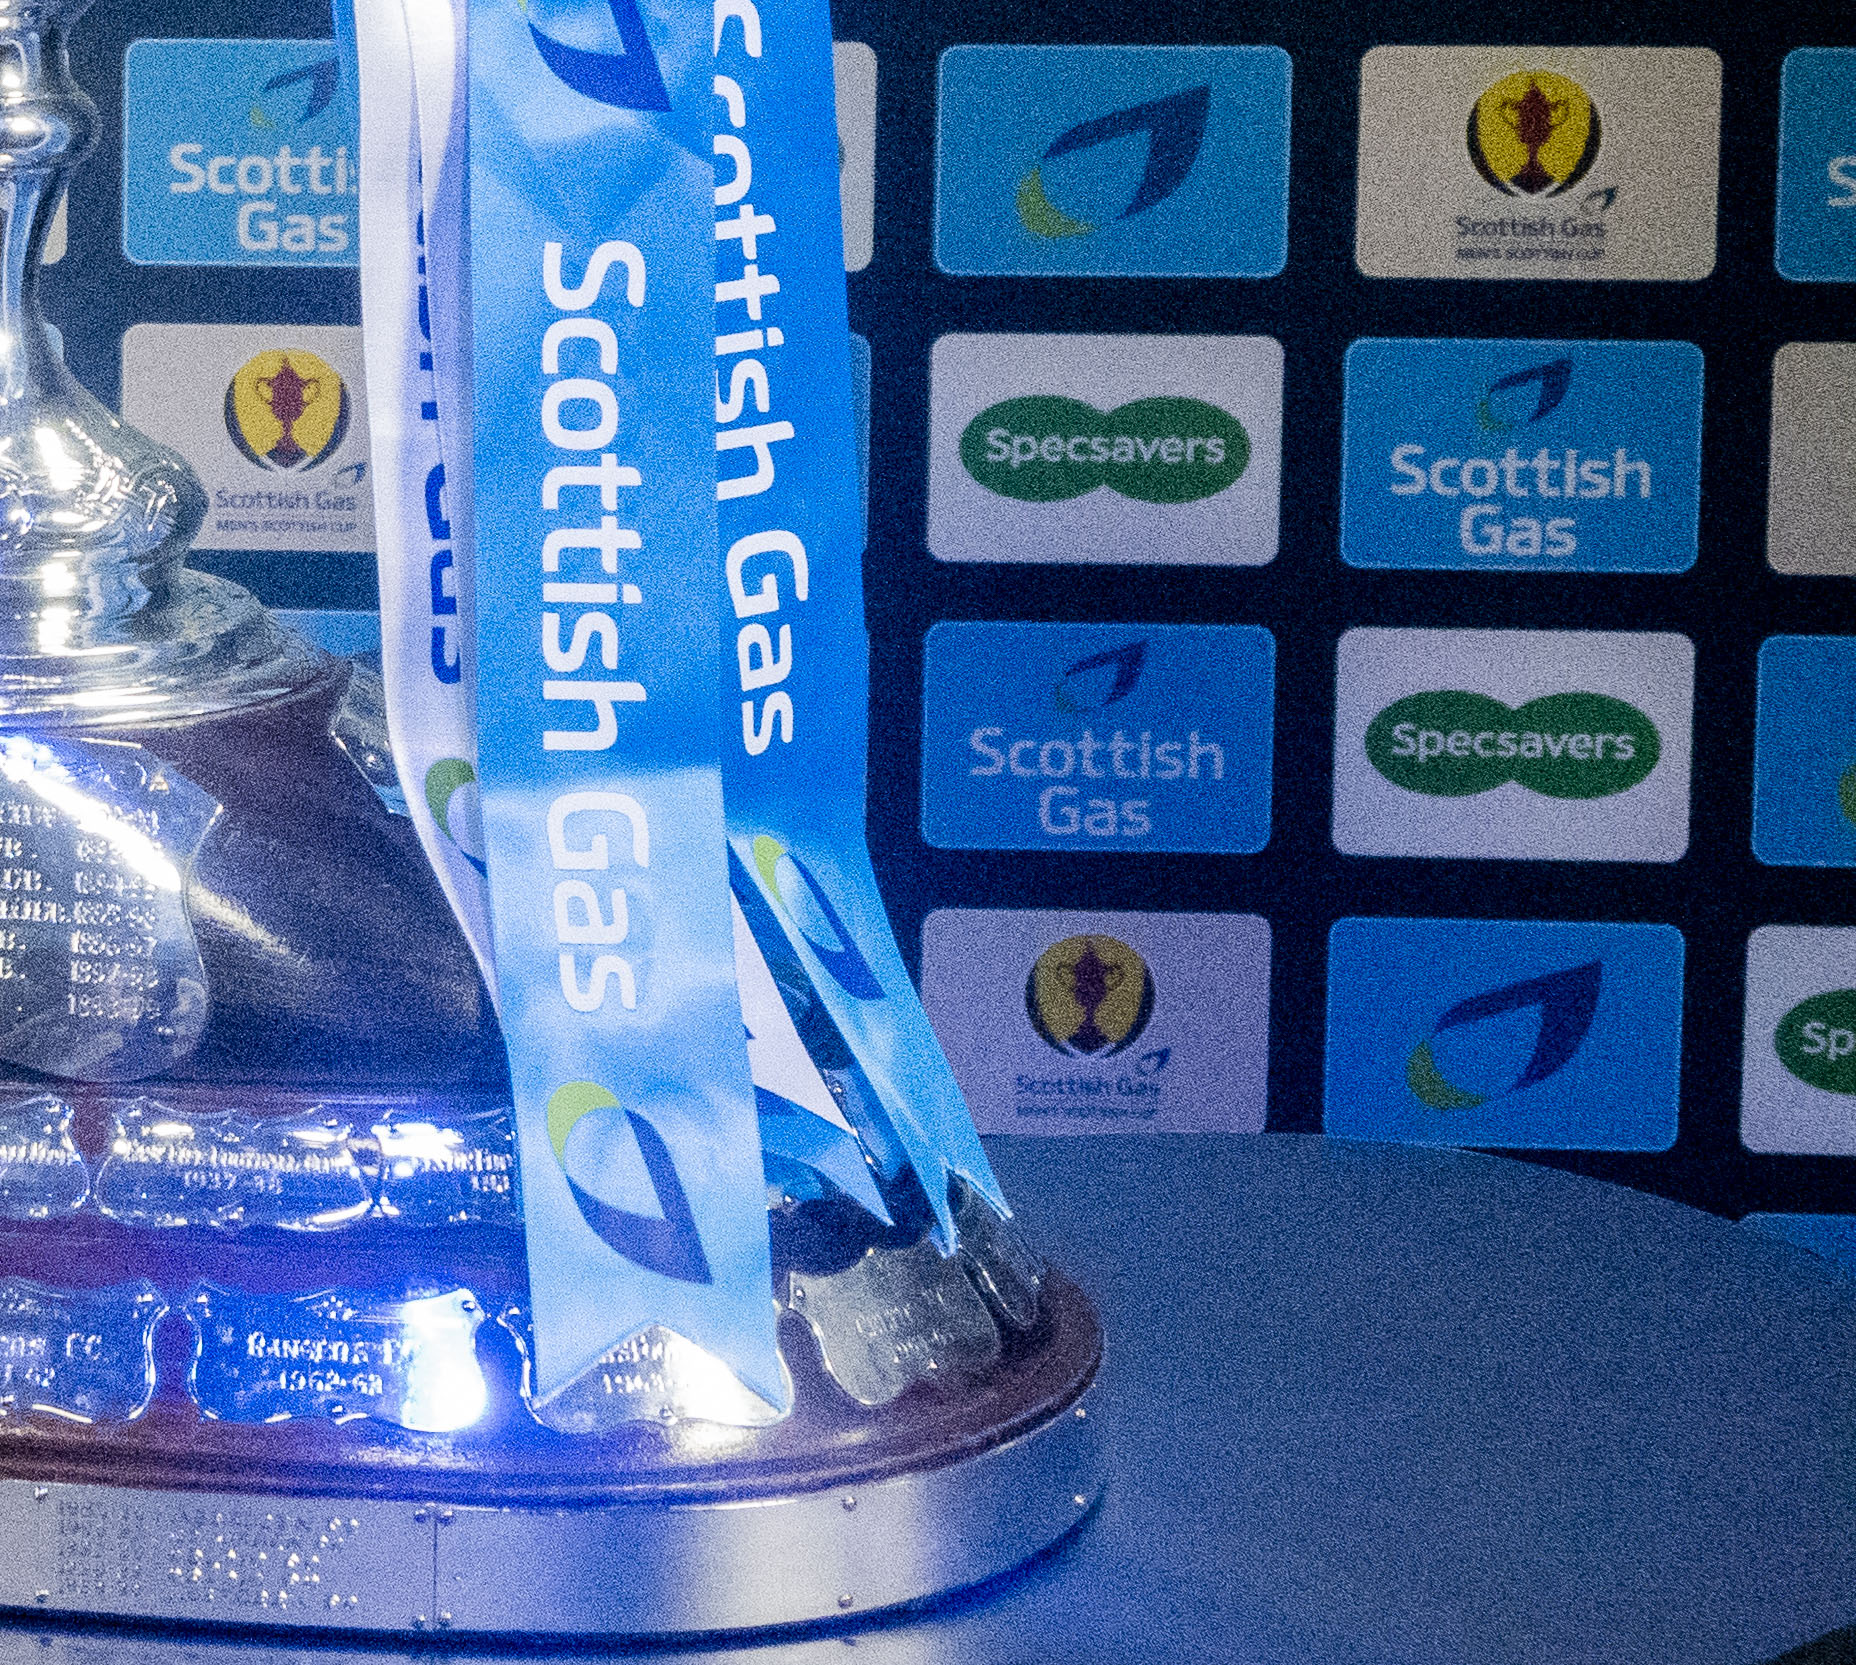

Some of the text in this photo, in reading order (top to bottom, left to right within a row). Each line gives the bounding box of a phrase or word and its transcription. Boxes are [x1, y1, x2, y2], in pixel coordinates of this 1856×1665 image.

[169, 142, 357, 194] Scotti
[238, 201, 349, 252] Gas
[1456, 217, 1607, 239] Scottish Gas
[985, 426, 1227, 469] Specsavers
[1390, 444, 1651, 498] Scottish
[215, 490, 357, 511] Scottish Gas
[1459, 504, 1577, 557] Gas
[541, 238, 651, 1014] Scottish Gas
[724, 529, 810, 757] Gas
[969, 726, 1224, 779] Scottish
[1391, 721, 1636, 763] Specsavers
[1038, 785, 1151, 837] Gas
